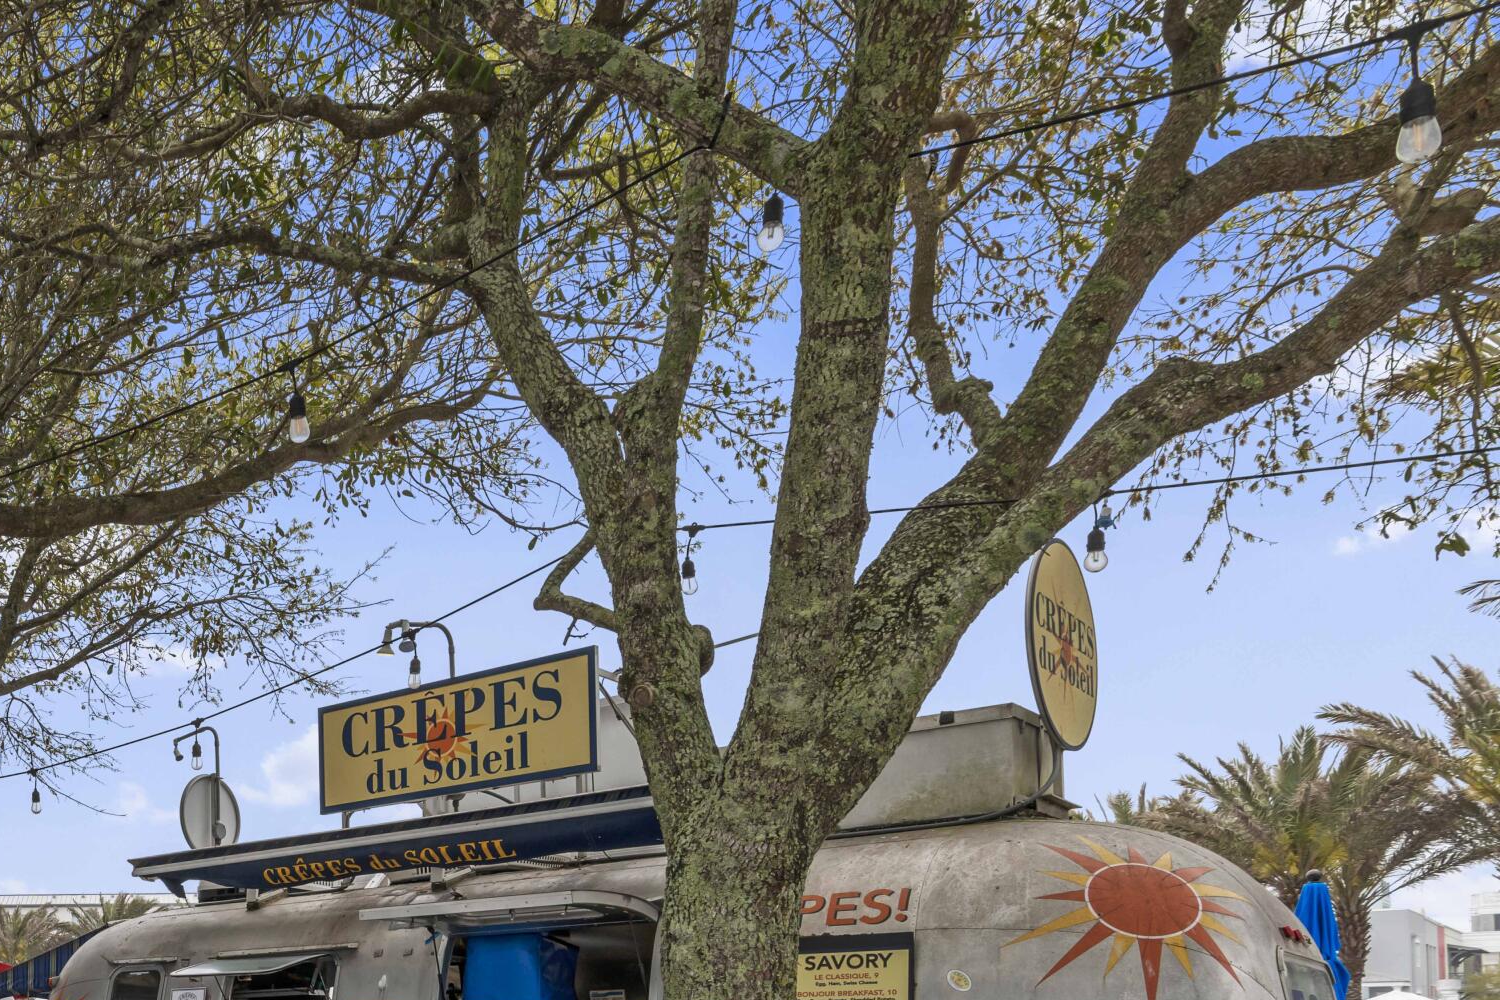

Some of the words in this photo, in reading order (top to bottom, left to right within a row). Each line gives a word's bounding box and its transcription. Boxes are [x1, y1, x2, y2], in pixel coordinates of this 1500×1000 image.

[1036, 591, 1094, 660] CRÊPES
[1039, 636, 1056, 675] du
[1060, 656, 1094, 698] Soleil
[341, 668, 562, 758] CRÊPES
[366, 759, 409, 794] du
[423, 731, 530, 785] Soleil
[263, 856, 362, 885] CRÊPES
[370, 853, 401, 871] du
[404, 839, 517, 866] SOLEIL
[800, 887, 912, 927] PES!
[805, 953, 893, 971] SAVORY
